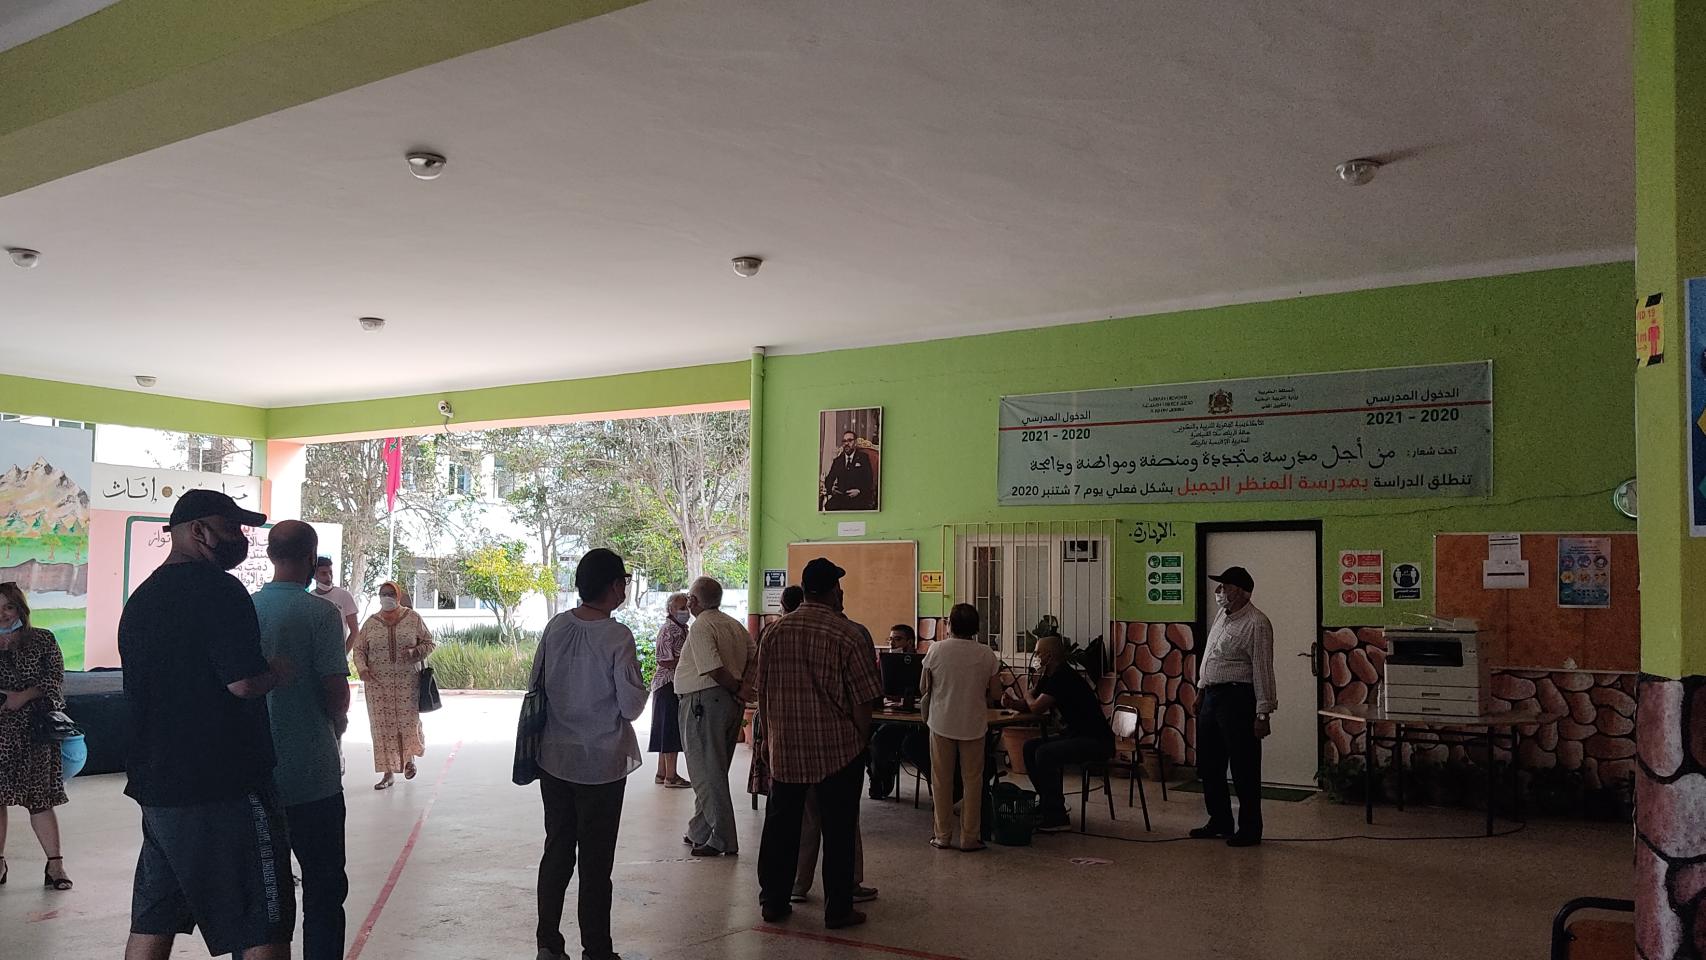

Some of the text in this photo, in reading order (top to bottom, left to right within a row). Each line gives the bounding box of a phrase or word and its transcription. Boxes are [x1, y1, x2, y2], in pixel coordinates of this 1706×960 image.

[1366, 387, 1459, 407] الدخول المدرسي
[1021, 410, 1091, 426] الدخول المدرسي
[1366, 411, 1402, 425] 2021
[1421, 408, 1459, 423] 2020
[1021, 430, 1049, 442] 2021
[1062, 428, 1091, 440] 2020
[1202, 448, 1258, 468] متجددة
[1262, 450, 1317, 470] مدرسة
[1322, 437, 1363, 469] أجل
[1369, 448, 1395, 469] من
[1438, 446, 1457, 455] تحت
[1030, 455, 1073, 475] ودامجة
[1076, 454, 1136, 474] ومواطنة
[1140, 455, 1199, 472] ومنصفة
[1011, 474, 1473, 499] تنطلق الدراسة بمدرسة المنظر الجميل بشكل فعلي يوم 7 شتنبر 2020
